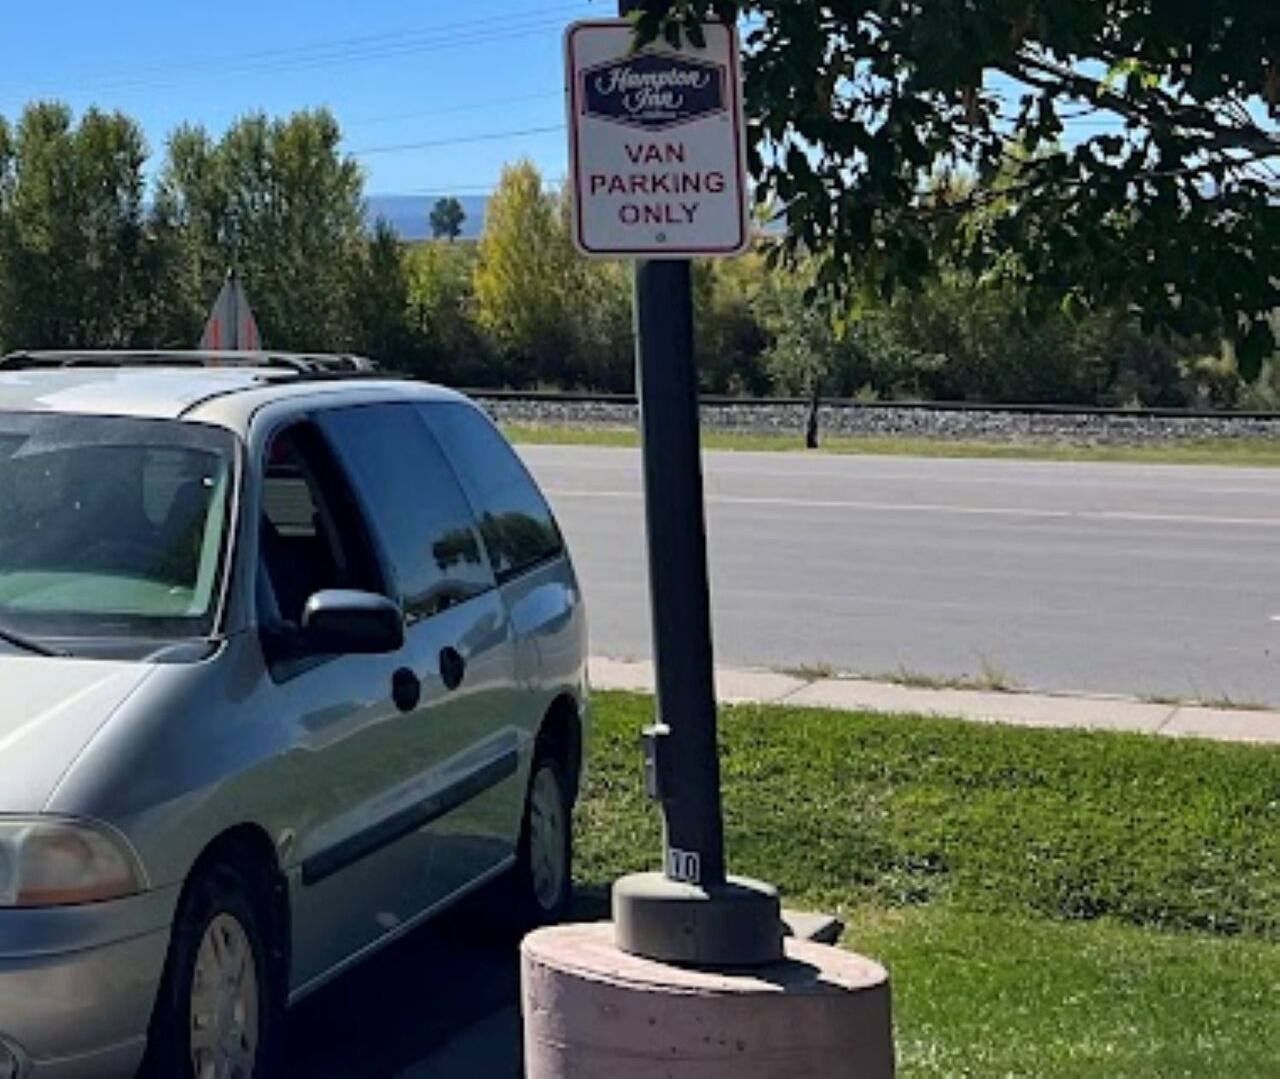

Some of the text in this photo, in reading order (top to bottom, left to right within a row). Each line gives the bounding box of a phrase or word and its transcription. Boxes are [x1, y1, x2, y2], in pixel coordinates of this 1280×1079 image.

[595, 67, 710, 95] Hampton
[622, 86, 683, 112] Inn
[624, 143, 685, 164] VAN
[590, 171, 726, 196] PARKING
[618, 201, 700, 224] ONLY
